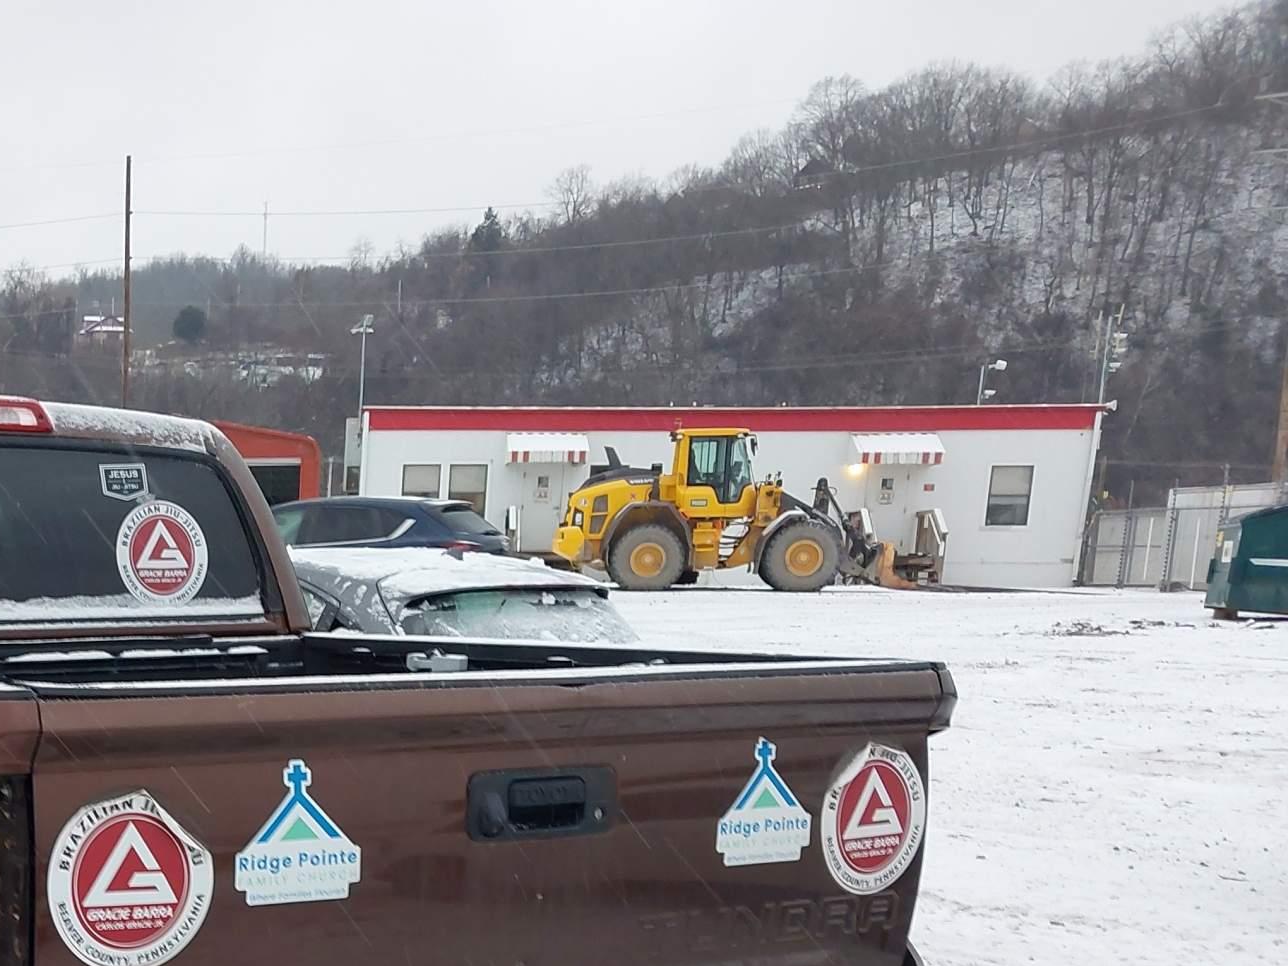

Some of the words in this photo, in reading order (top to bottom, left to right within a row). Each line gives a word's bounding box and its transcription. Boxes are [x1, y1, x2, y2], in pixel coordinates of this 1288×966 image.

[109, 470, 139, 479] JESUS
[122, 504, 161, 547] BRAZILIAN
[165, 506, 203, 548] JIU-JITSU
[174, 563, 203, 602] NNSYLVANIA
[880, 749, 920, 801] JIU-JITSU
[59, 799, 134, 872] BRAZILIAN
[720, 820, 760, 837] Ridge
[765, 816, 808, 832] Pointe
[239, 855, 292, 874] Ridge
[298, 850, 358, 868] Pointe
[874, 824, 920, 885] PENNSYLVANIA
[241, 873, 289, 888] AMILY
[86, 908, 132, 922] GRACIE
[132, 905, 174, 919] BARRA
[136, 893, 206, 965] PENNSYLVANIA
